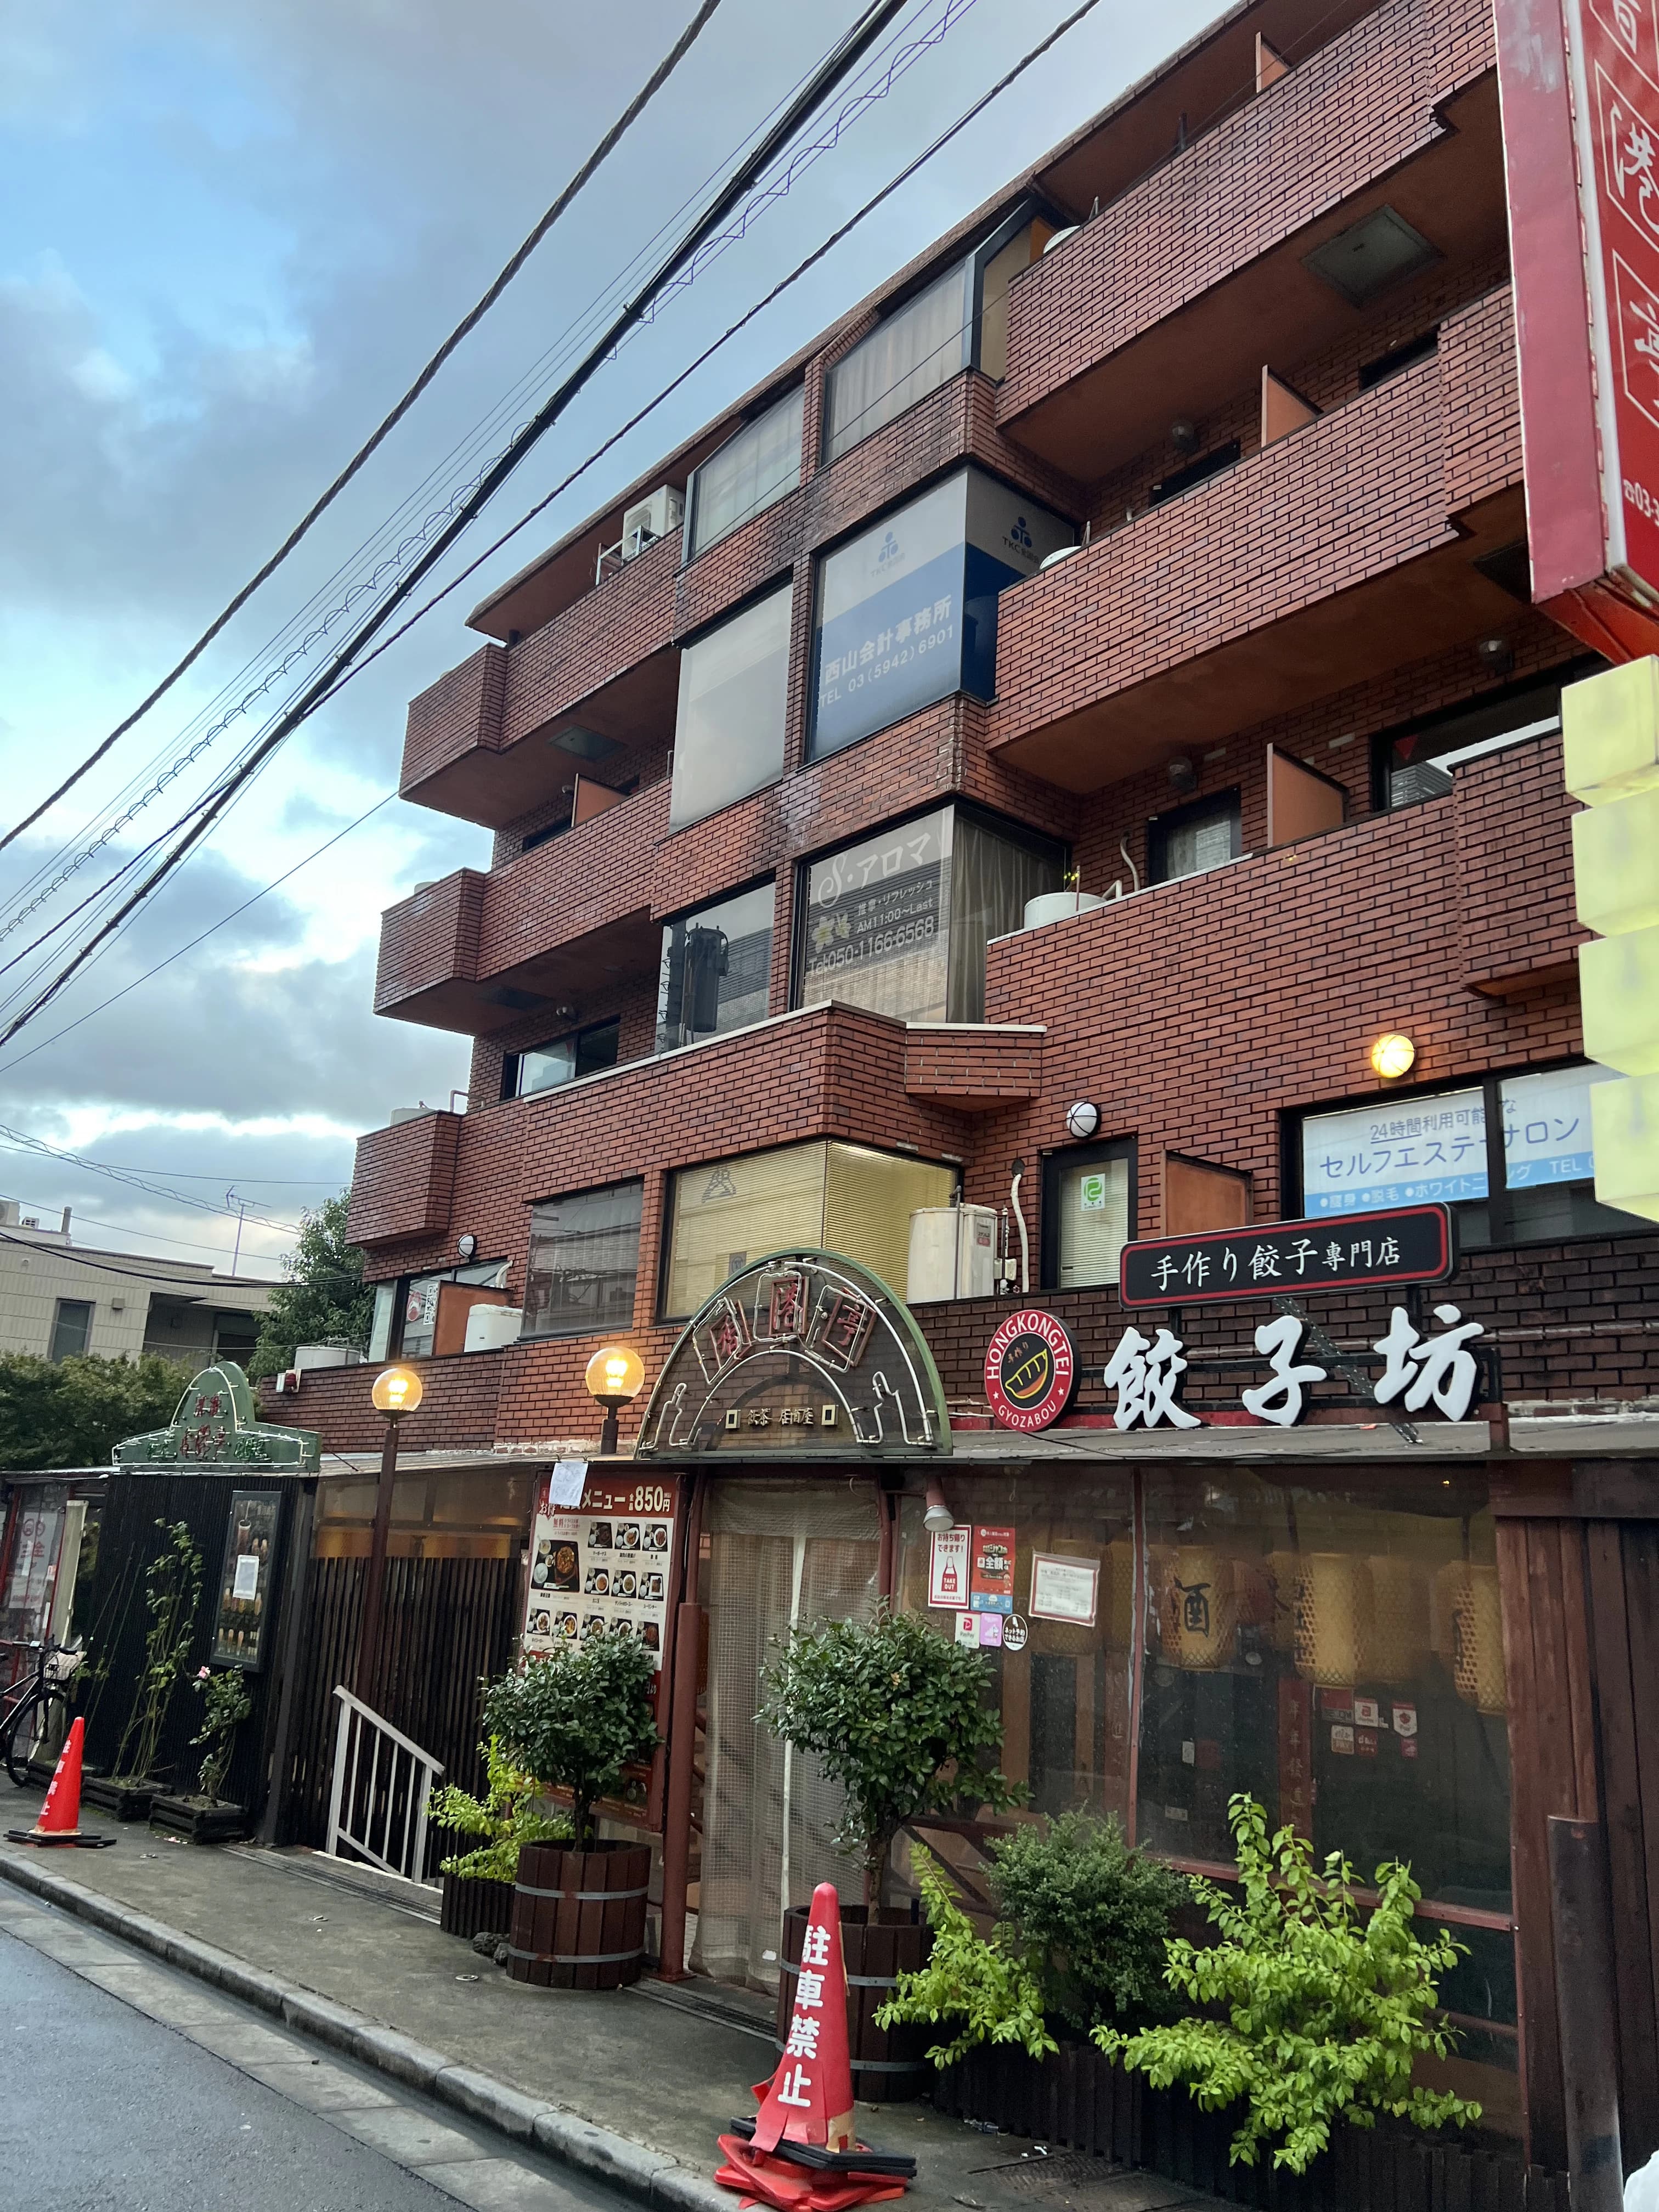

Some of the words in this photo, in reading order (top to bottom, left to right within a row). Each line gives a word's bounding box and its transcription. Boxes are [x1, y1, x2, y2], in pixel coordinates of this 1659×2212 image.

[825, 594, 952, 685] 西山会計事務所
[820, 687, 842, 708] TEL
[1549, 1158, 1582, 1174] TEL
[986, 1313, 1070, 1380] HONGKONGTEI
[1104, 1305, 1484, 1430] 餃子坊
[998, 1400, 1057, 1428] GYOZABOU
[634, 1486, 671, 1513] 850円
[777, 1925, 831, 2108] 駐車禁止
